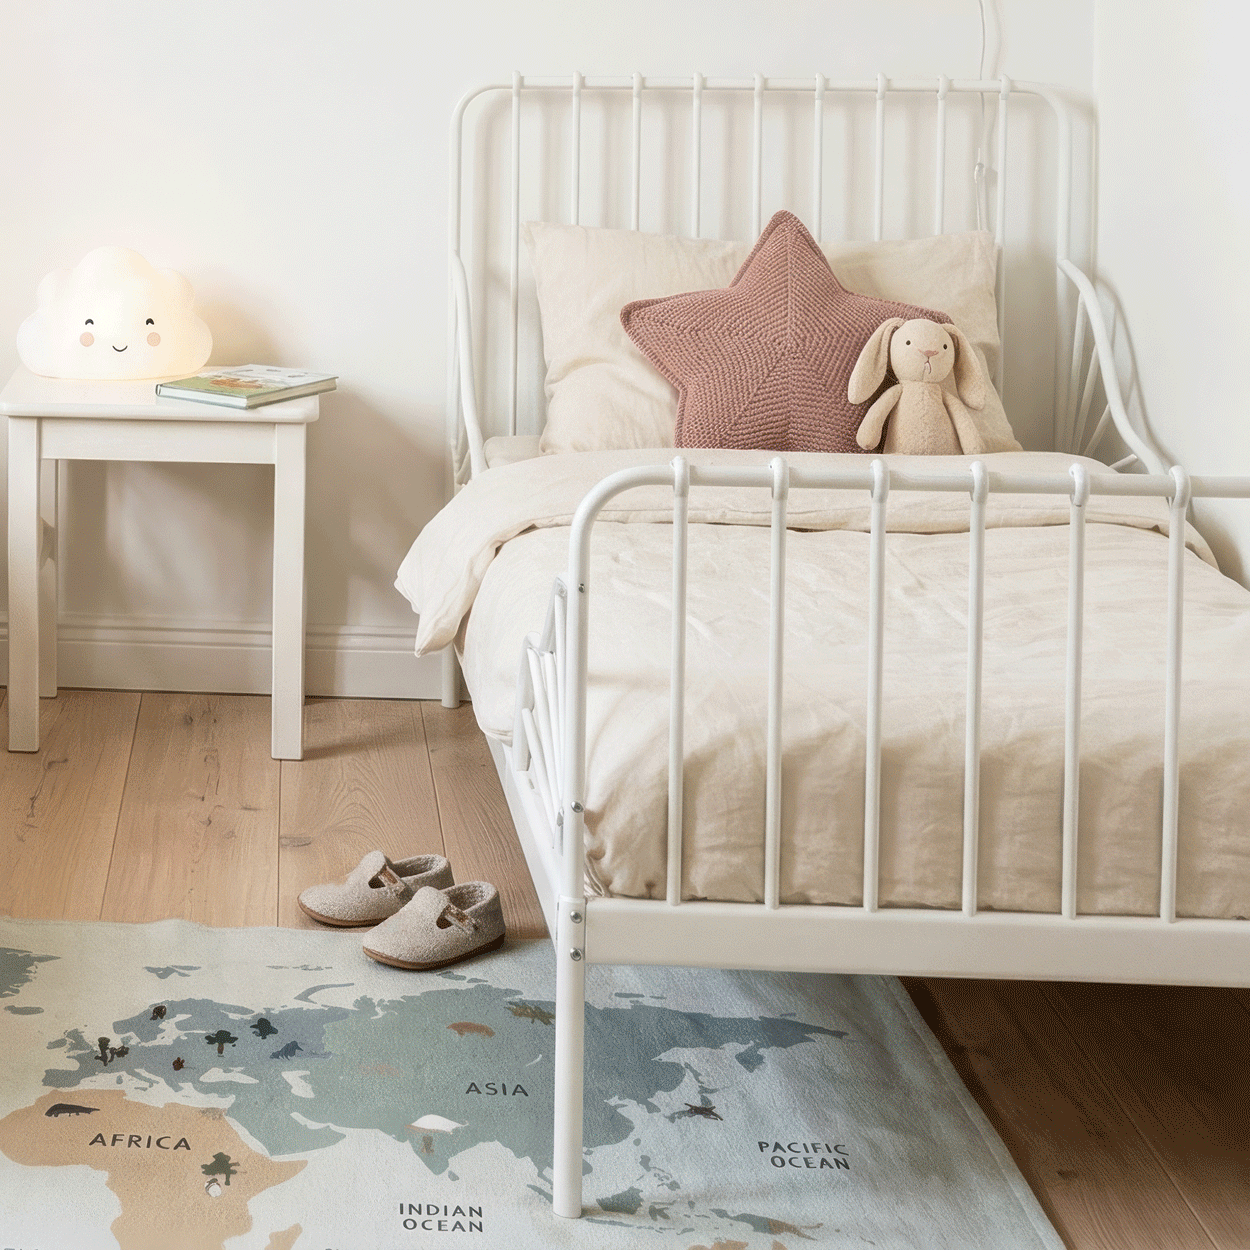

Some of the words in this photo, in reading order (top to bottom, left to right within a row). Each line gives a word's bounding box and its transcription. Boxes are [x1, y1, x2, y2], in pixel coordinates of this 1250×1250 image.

[465, 1082, 529, 1097] ASIA
[88, 1132, 192, 1151] AFRICA
[757, 1141, 850, 1157] PACIFIC
[770, 1155, 850, 1171] OCEAN
[399, 1203, 484, 1219] INDIAN
[402, 1218, 484, 1233] OCEAN
